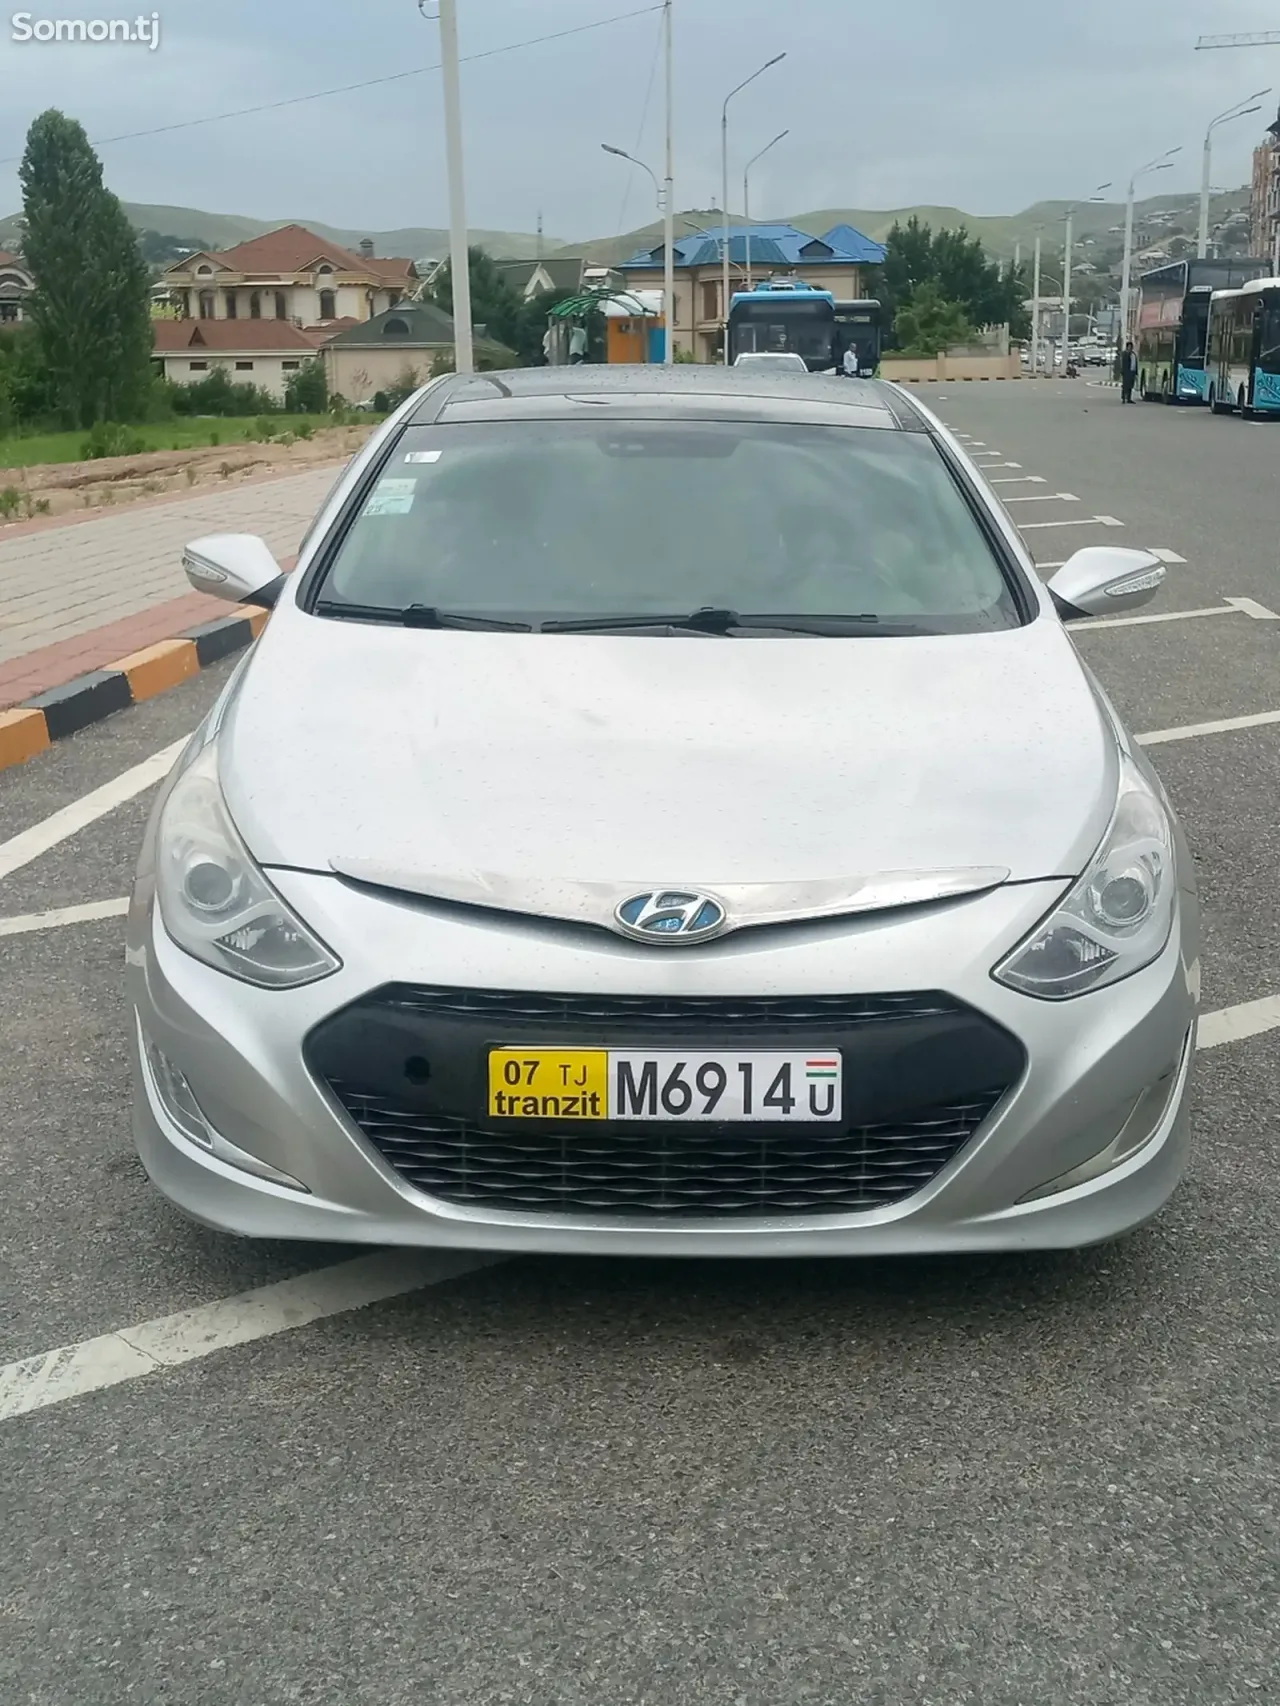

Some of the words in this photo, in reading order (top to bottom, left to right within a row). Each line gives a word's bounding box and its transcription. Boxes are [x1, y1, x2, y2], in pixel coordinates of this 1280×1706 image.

[503, 1060, 540, 1086] 07
[558, 1064, 588, 1087] TJ
[494, 1089, 601, 1117] tranzit
[616, 1061, 796, 1116] M6914
[809, 1084, 835, 1117] U
